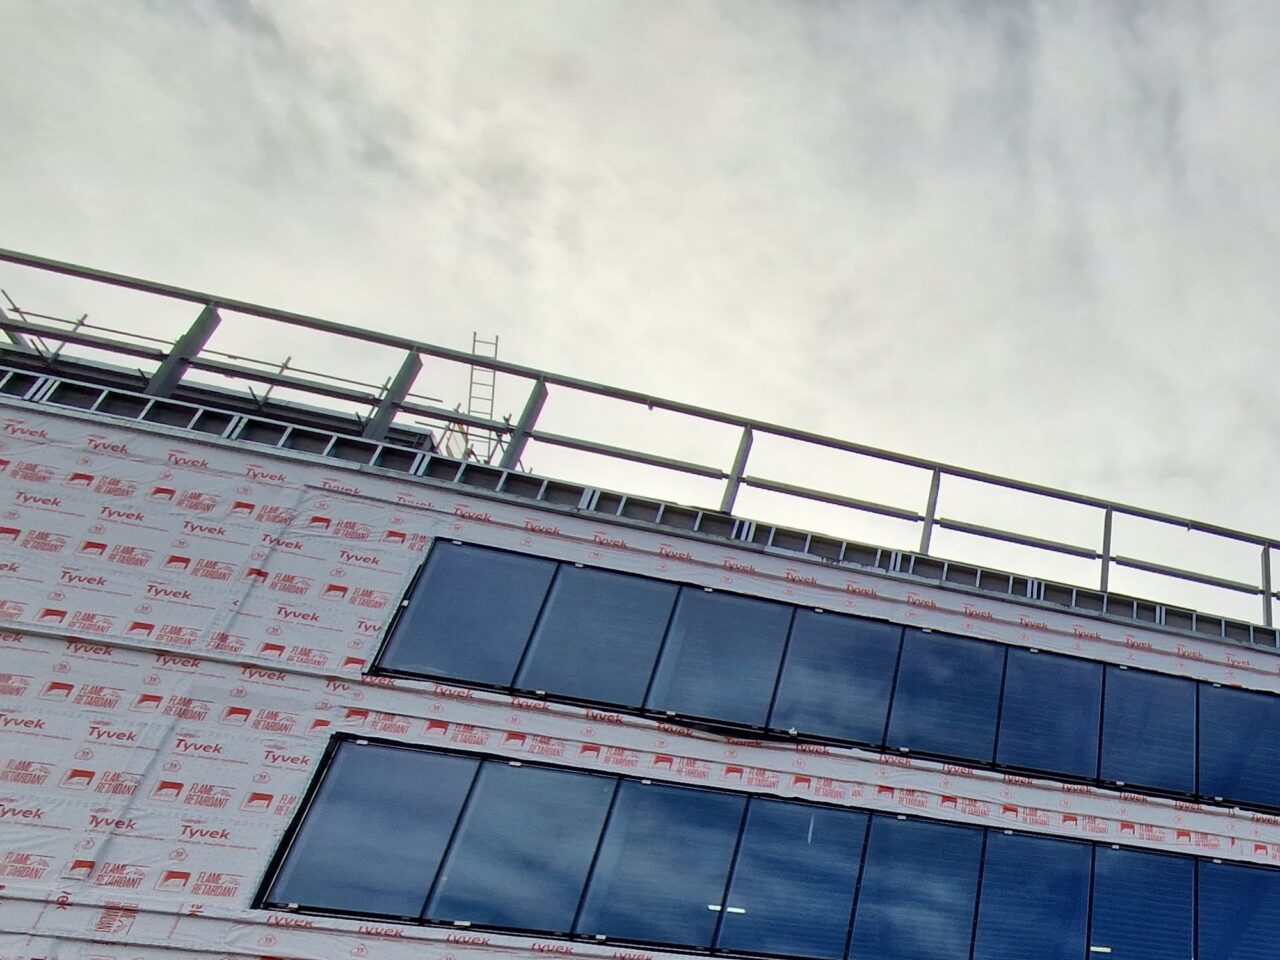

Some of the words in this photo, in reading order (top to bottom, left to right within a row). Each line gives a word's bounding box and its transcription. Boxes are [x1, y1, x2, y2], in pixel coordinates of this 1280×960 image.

[3, 423, 48, 438] Tyvek
[88, 438, 128, 454] Tyvek
[168, 454, 209, 468] Tyvek
[246, 468, 287, 482] Tyvek
[16, 491, 62, 506] Tyvek
[100, 506, 144, 521] Tyvek
[453, 506, 492, 522] Tyvek
[183, 520, 226, 536] Tyvek
[524, 520, 560, 536] Tyvek
[262, 534, 303, 550] Tyvek
[592, 534, 628, 548] Tyvek
[339, 550, 380, 565] Tyvek
[658, 547, 693, 560] Tyvek
[723, 559, 757, 573] Tyvek
[61, 570, 107, 586] Tyvek
[785, 570, 818, 586] Tyvek
[148, 585, 192, 600] Tyvek
[276, 606, 320, 622] Tyvek
[66, 642, 112, 656] Tyvek
[154, 655, 200, 668] Tyvek
[240, 666, 286, 682] Tyvek
[89, 726, 138, 742] Tyvek
[175, 738, 223, 754] Tyvek
[264, 751, 310, 766] Tyvek
[89, 815, 137, 830] Tyvek
[182, 825, 230, 839] Tyvek
